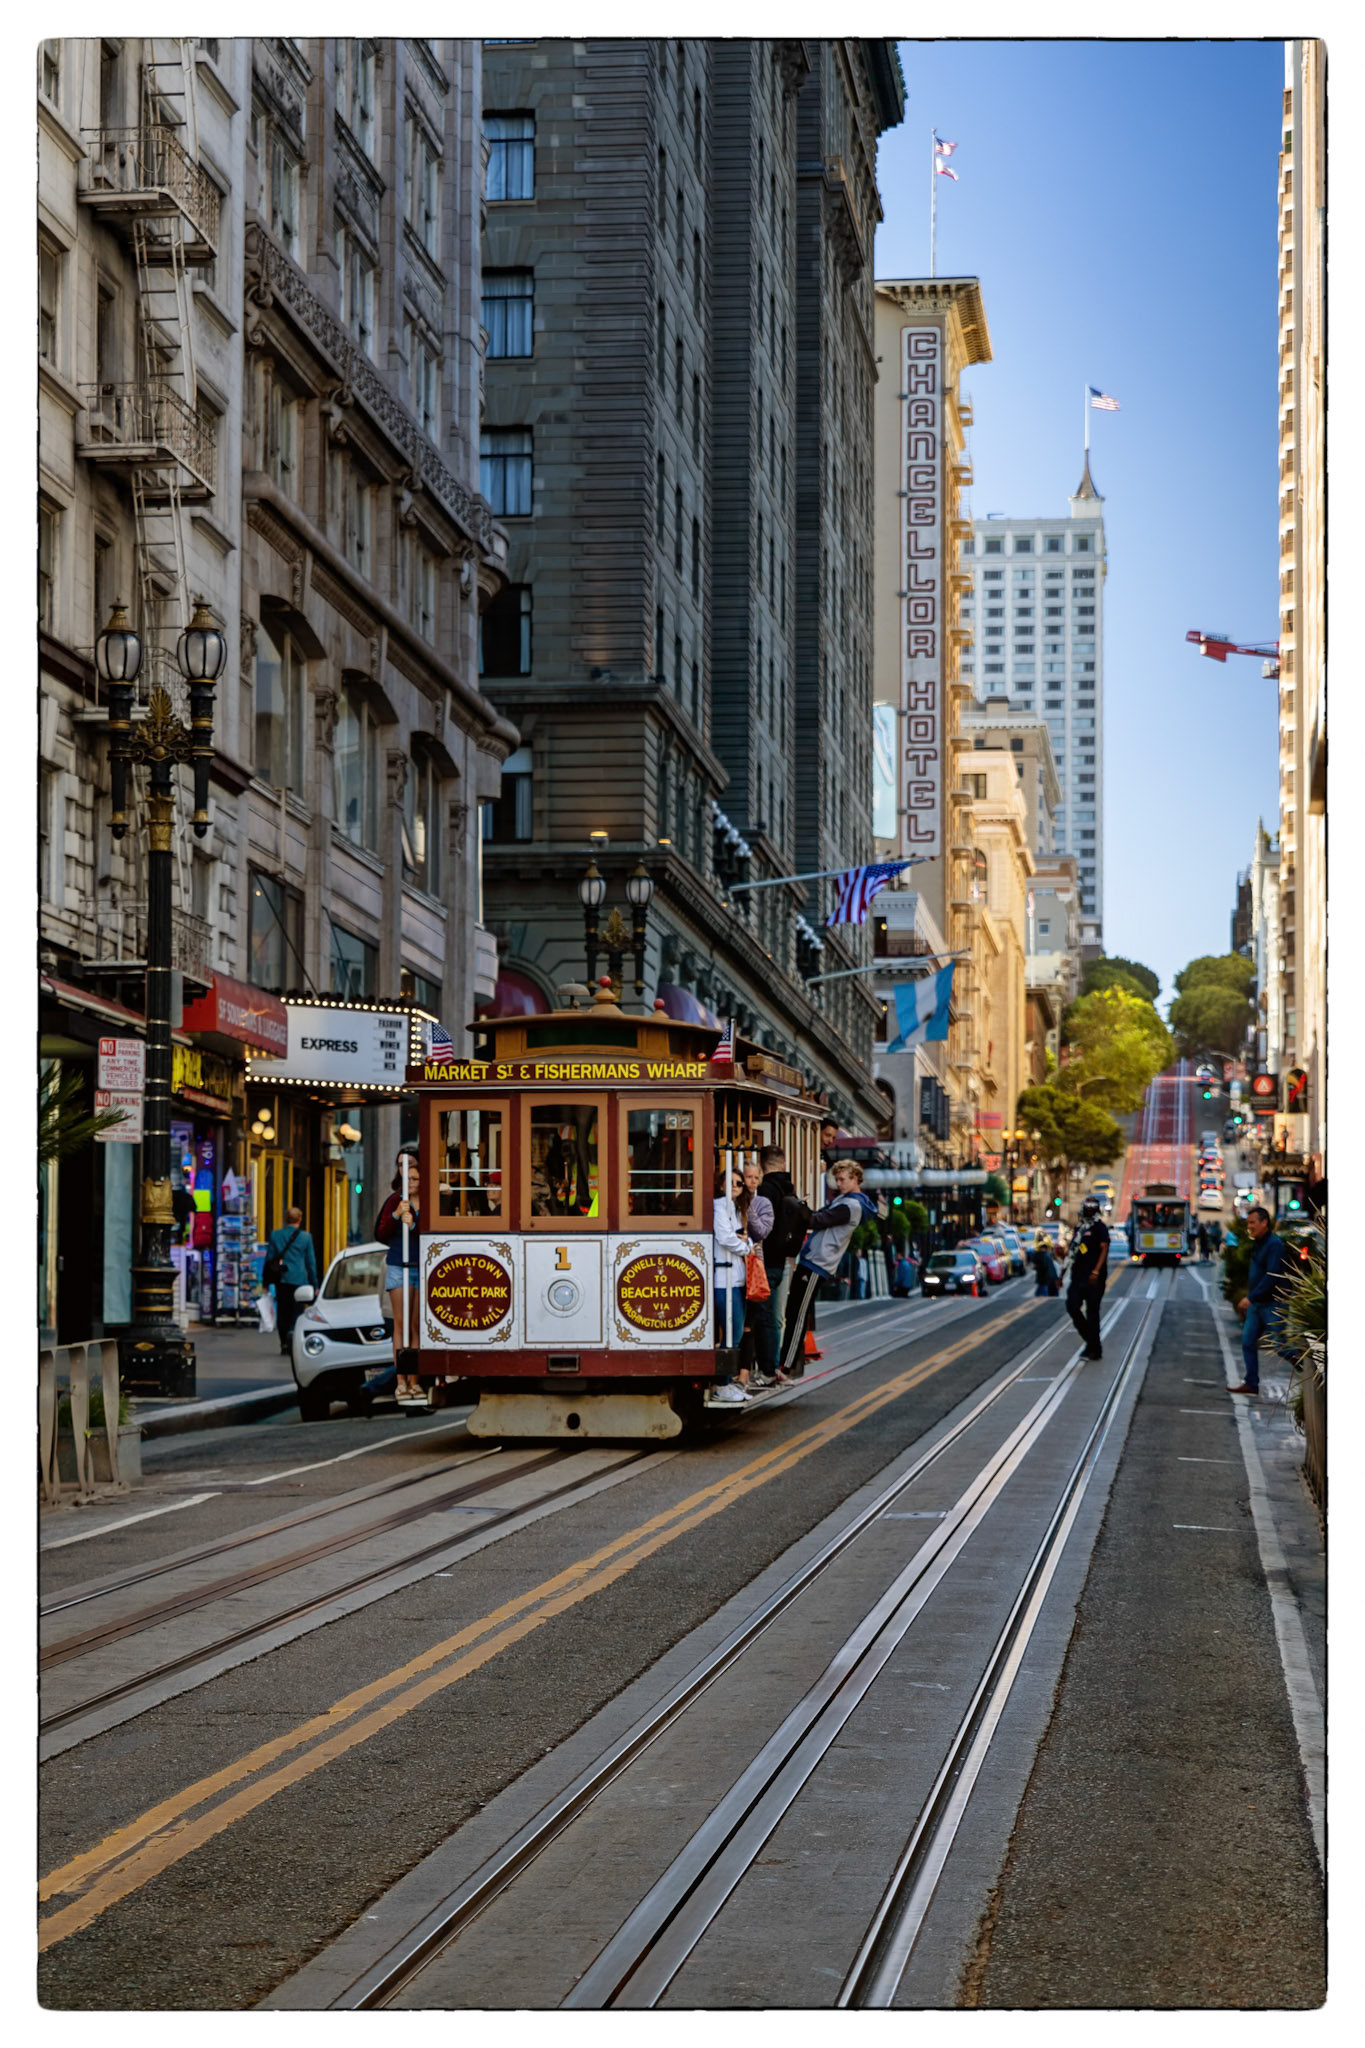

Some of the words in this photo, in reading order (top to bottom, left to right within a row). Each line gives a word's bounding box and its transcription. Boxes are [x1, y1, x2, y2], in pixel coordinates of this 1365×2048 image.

[907, 332, 937, 658] CHANCELLOR
[906, 681, 937, 843] HOTEL
[379, 1019, 402, 1029] FASHION
[386, 1031, 396, 1039] FOR
[101, 1041, 114, 1055] NO
[301, 1037, 358, 1053] EXPRESS
[381, 1040, 400, 1050] WOMEN
[384, 1062, 396, 1071] MEN
[424, 1065, 489, 1080] MARKET
[520, 1064, 531, 1079] &
[535, 1064, 641, 1079] FISHERMANS
[647, 1063, 707, 1078] WHARF
[97, 1092, 109, 1106] NO
[112, 1096, 140, 1106] PARKING
[668, 1116, 690, 1129] 32
[556, 1247, 571, 1270] 1
[437, 1257, 503, 1279] CHINATOWN
[623, 1258, 656, 1284] POWELL
[657, 1257, 664, 1266] &
[665, 1257, 700, 1282] MARKET
[654, 1275, 668, 1283] TO
[431, 1286, 479, 1298] AQUATIC
[481, 1287, 508, 1298] PARK
[621, 1286, 659, 1299] BEACH
[660, 1286, 668, 1298] &
[669, 1285, 701, 1297] HYDE
[622, 1300, 667, 1328] WASHINGTON
[667, 1319, 674, 1328] &
[674, 1300, 701, 1328] JACKSON
[653, 1303, 670, 1311] VIA
[435, 1305, 478, 1328] RUSSIAN
[481, 1307, 505, 1326] HILL
